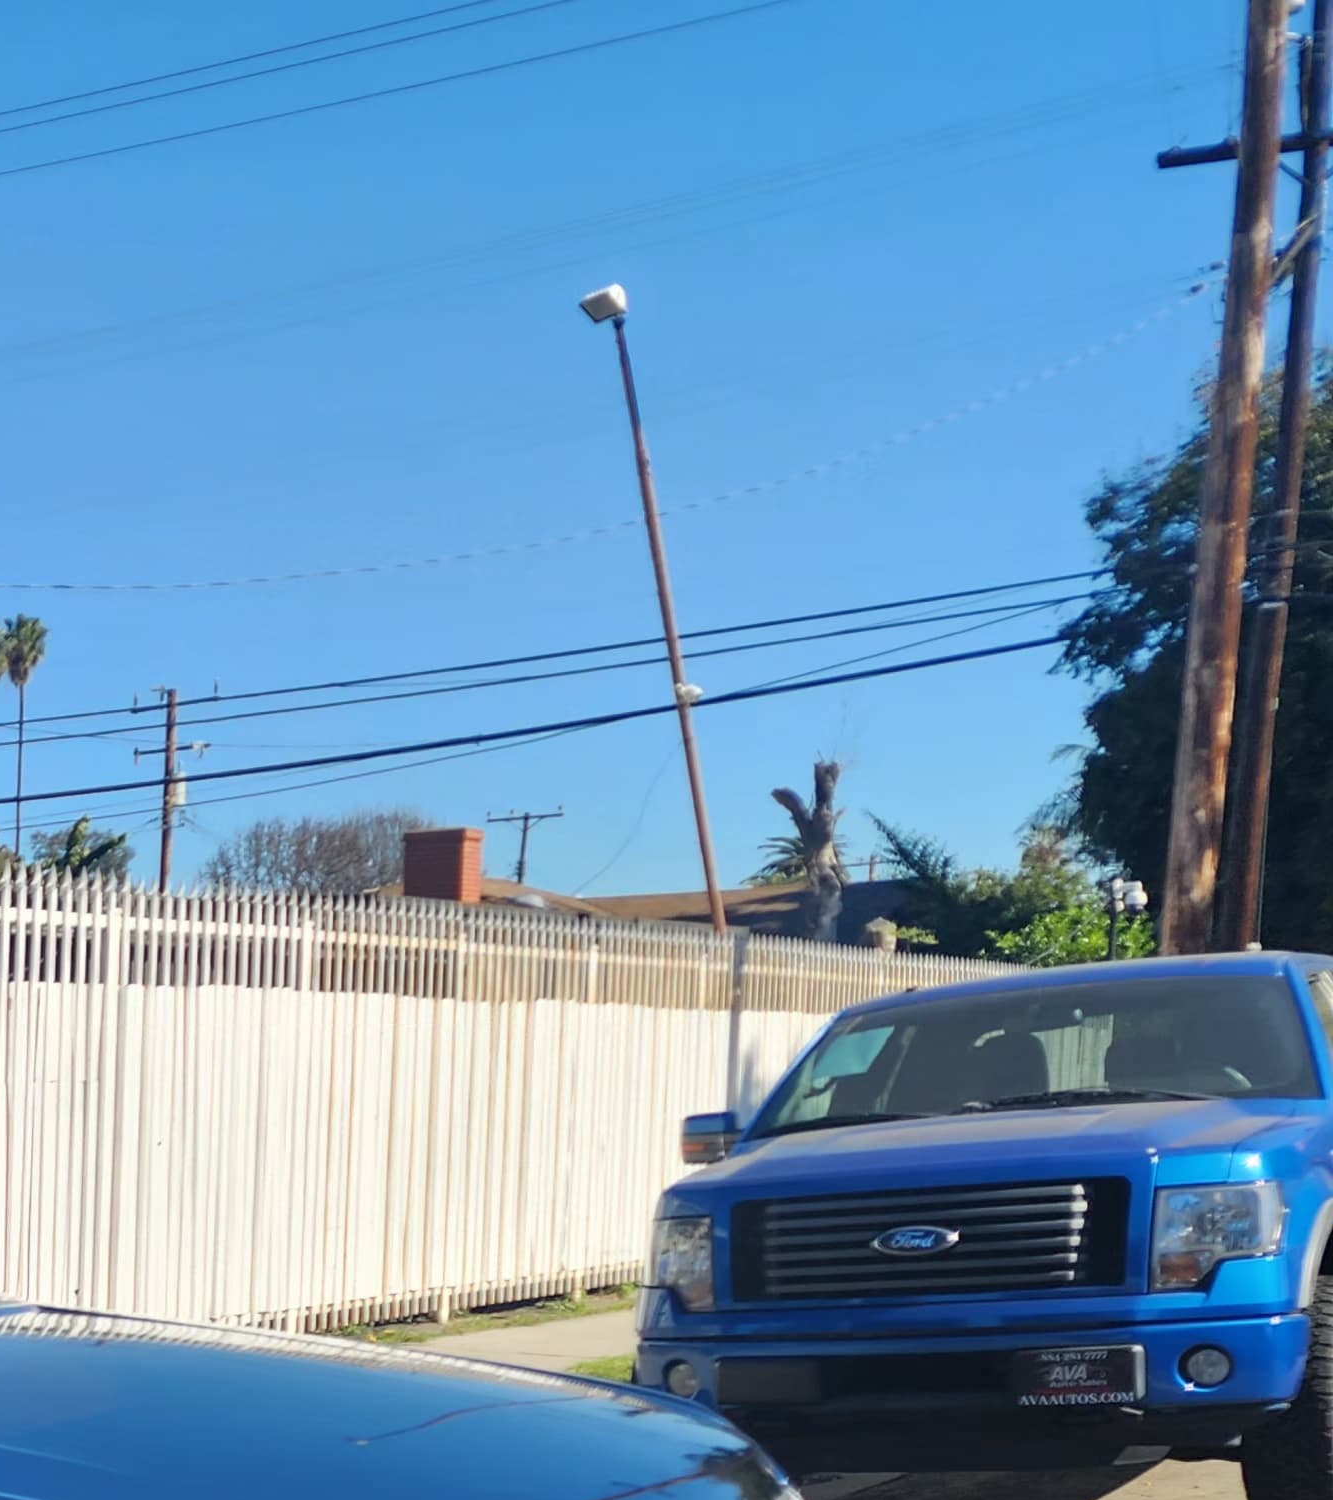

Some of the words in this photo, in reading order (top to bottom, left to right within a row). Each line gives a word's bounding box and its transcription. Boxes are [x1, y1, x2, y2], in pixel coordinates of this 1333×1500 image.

[891, 1231, 936, 1249] Ford
[1051, 1365, 1087, 1381] AVA
[1019, 1391, 1134, 1406] AVAAUTOS.COM
